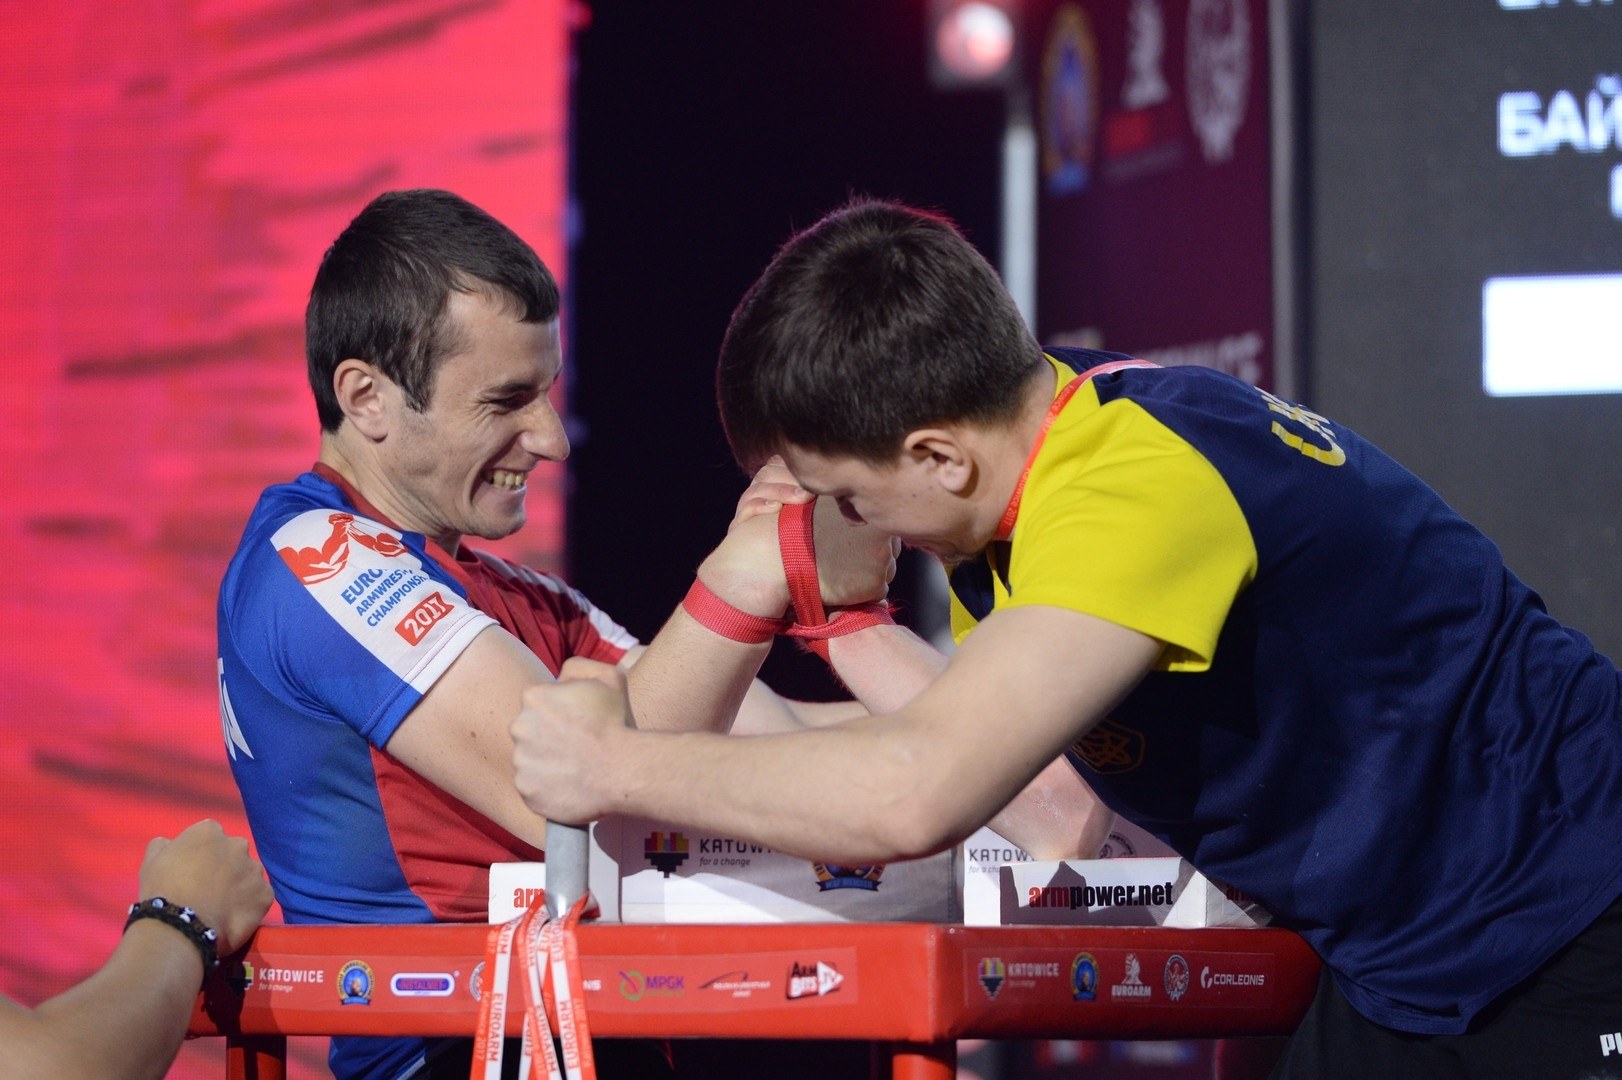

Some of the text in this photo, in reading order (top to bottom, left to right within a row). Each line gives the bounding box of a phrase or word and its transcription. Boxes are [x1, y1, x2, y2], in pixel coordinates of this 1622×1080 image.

[404, 597, 446, 639] 2017
[700, 838, 771, 853] KATOW
[699, 857, 712, 867] for
[721, 857, 751, 868] change
[969, 849, 1034, 861] KATOW
[1029, 882, 1173, 909] armpower.net
[259, 967, 324, 983] KATOWICE
[1008, 962, 1060, 977] KATOWICE
[646, 975, 684, 989] MPGK
[1213, 973, 1265, 985] CORLEONIS
[1112, 984, 1152, 996] EUROARM
[475, 991, 491, 1061] Katowice 2017
[487, 993, 504, 1062] EUROARM
[535, 1004, 557, 1073] EUROARM
[559, 999, 580, 1070] EUROARM
